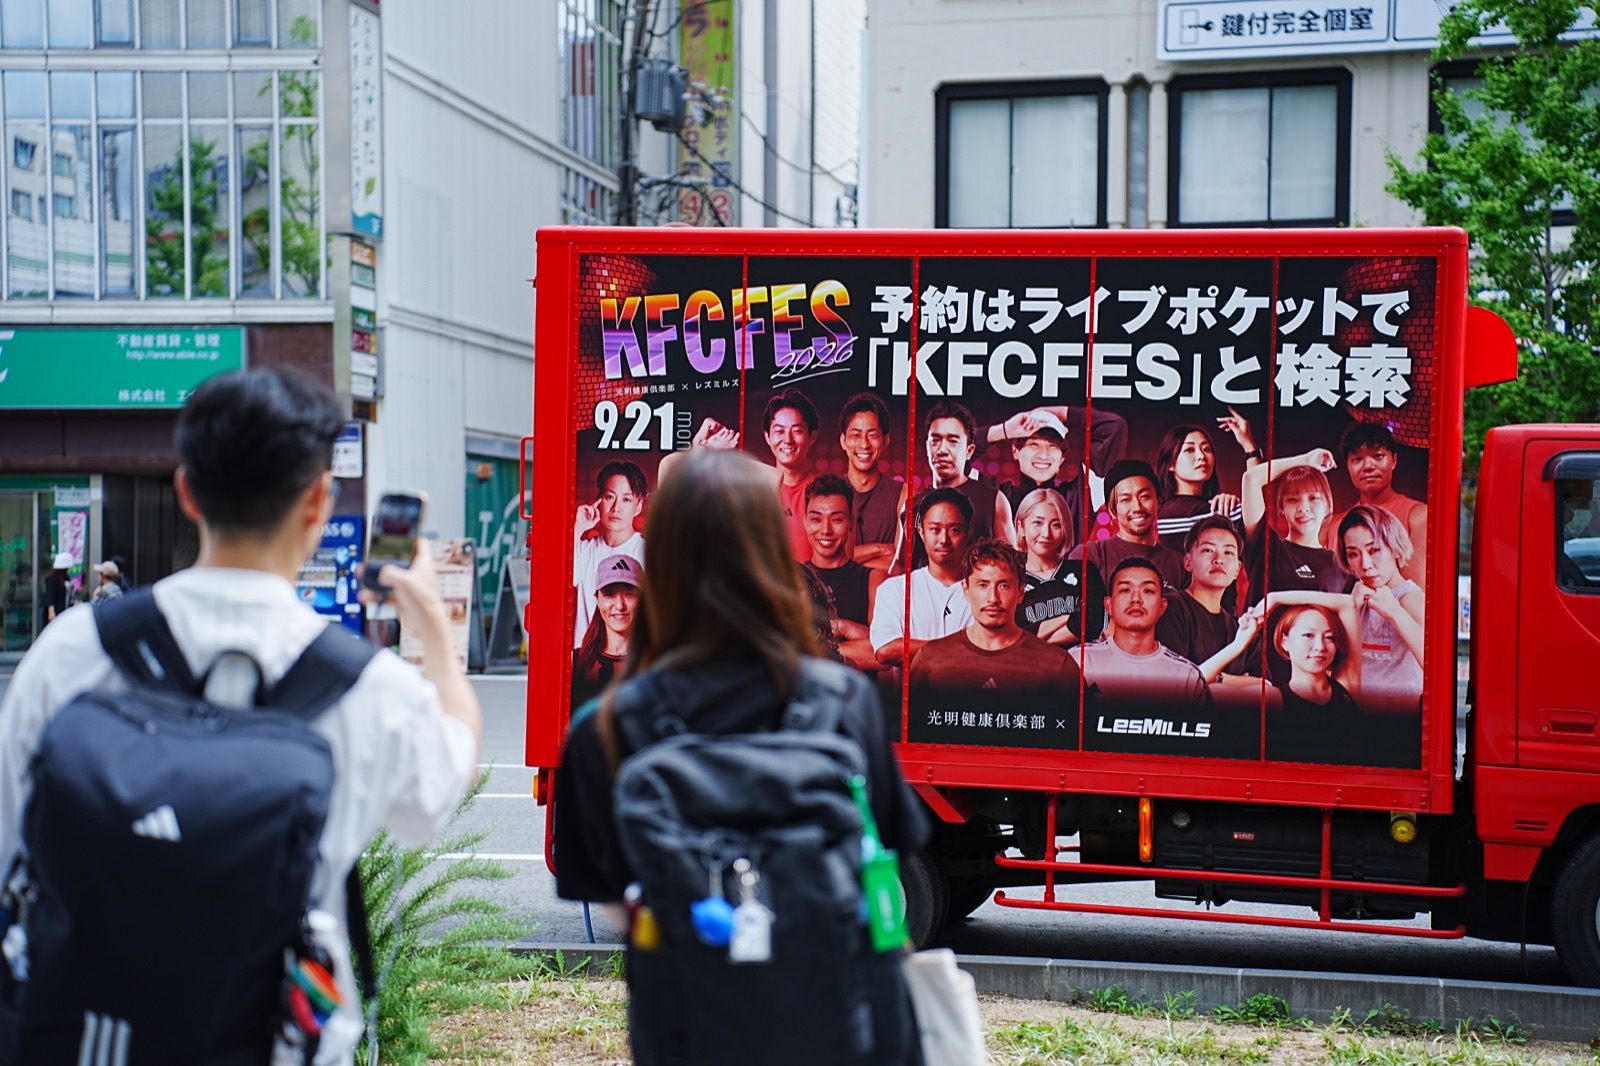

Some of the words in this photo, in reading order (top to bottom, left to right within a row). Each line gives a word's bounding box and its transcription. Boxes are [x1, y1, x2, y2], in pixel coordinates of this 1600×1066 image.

[1221, 8, 1374, 37] 鍵付完全個室
[870, 284, 1411, 337] 予約はライブポケットで
[600, 279, 854, 380] KFCFES
[770, 336, 859, 380] 2026
[118, 388, 166, 402] 株式会社
[695, 378, 740, 390] レズミルズ
[594, 400, 674, 451] 9.21
[927, 709, 1046, 730] 光明健康倶楽部
